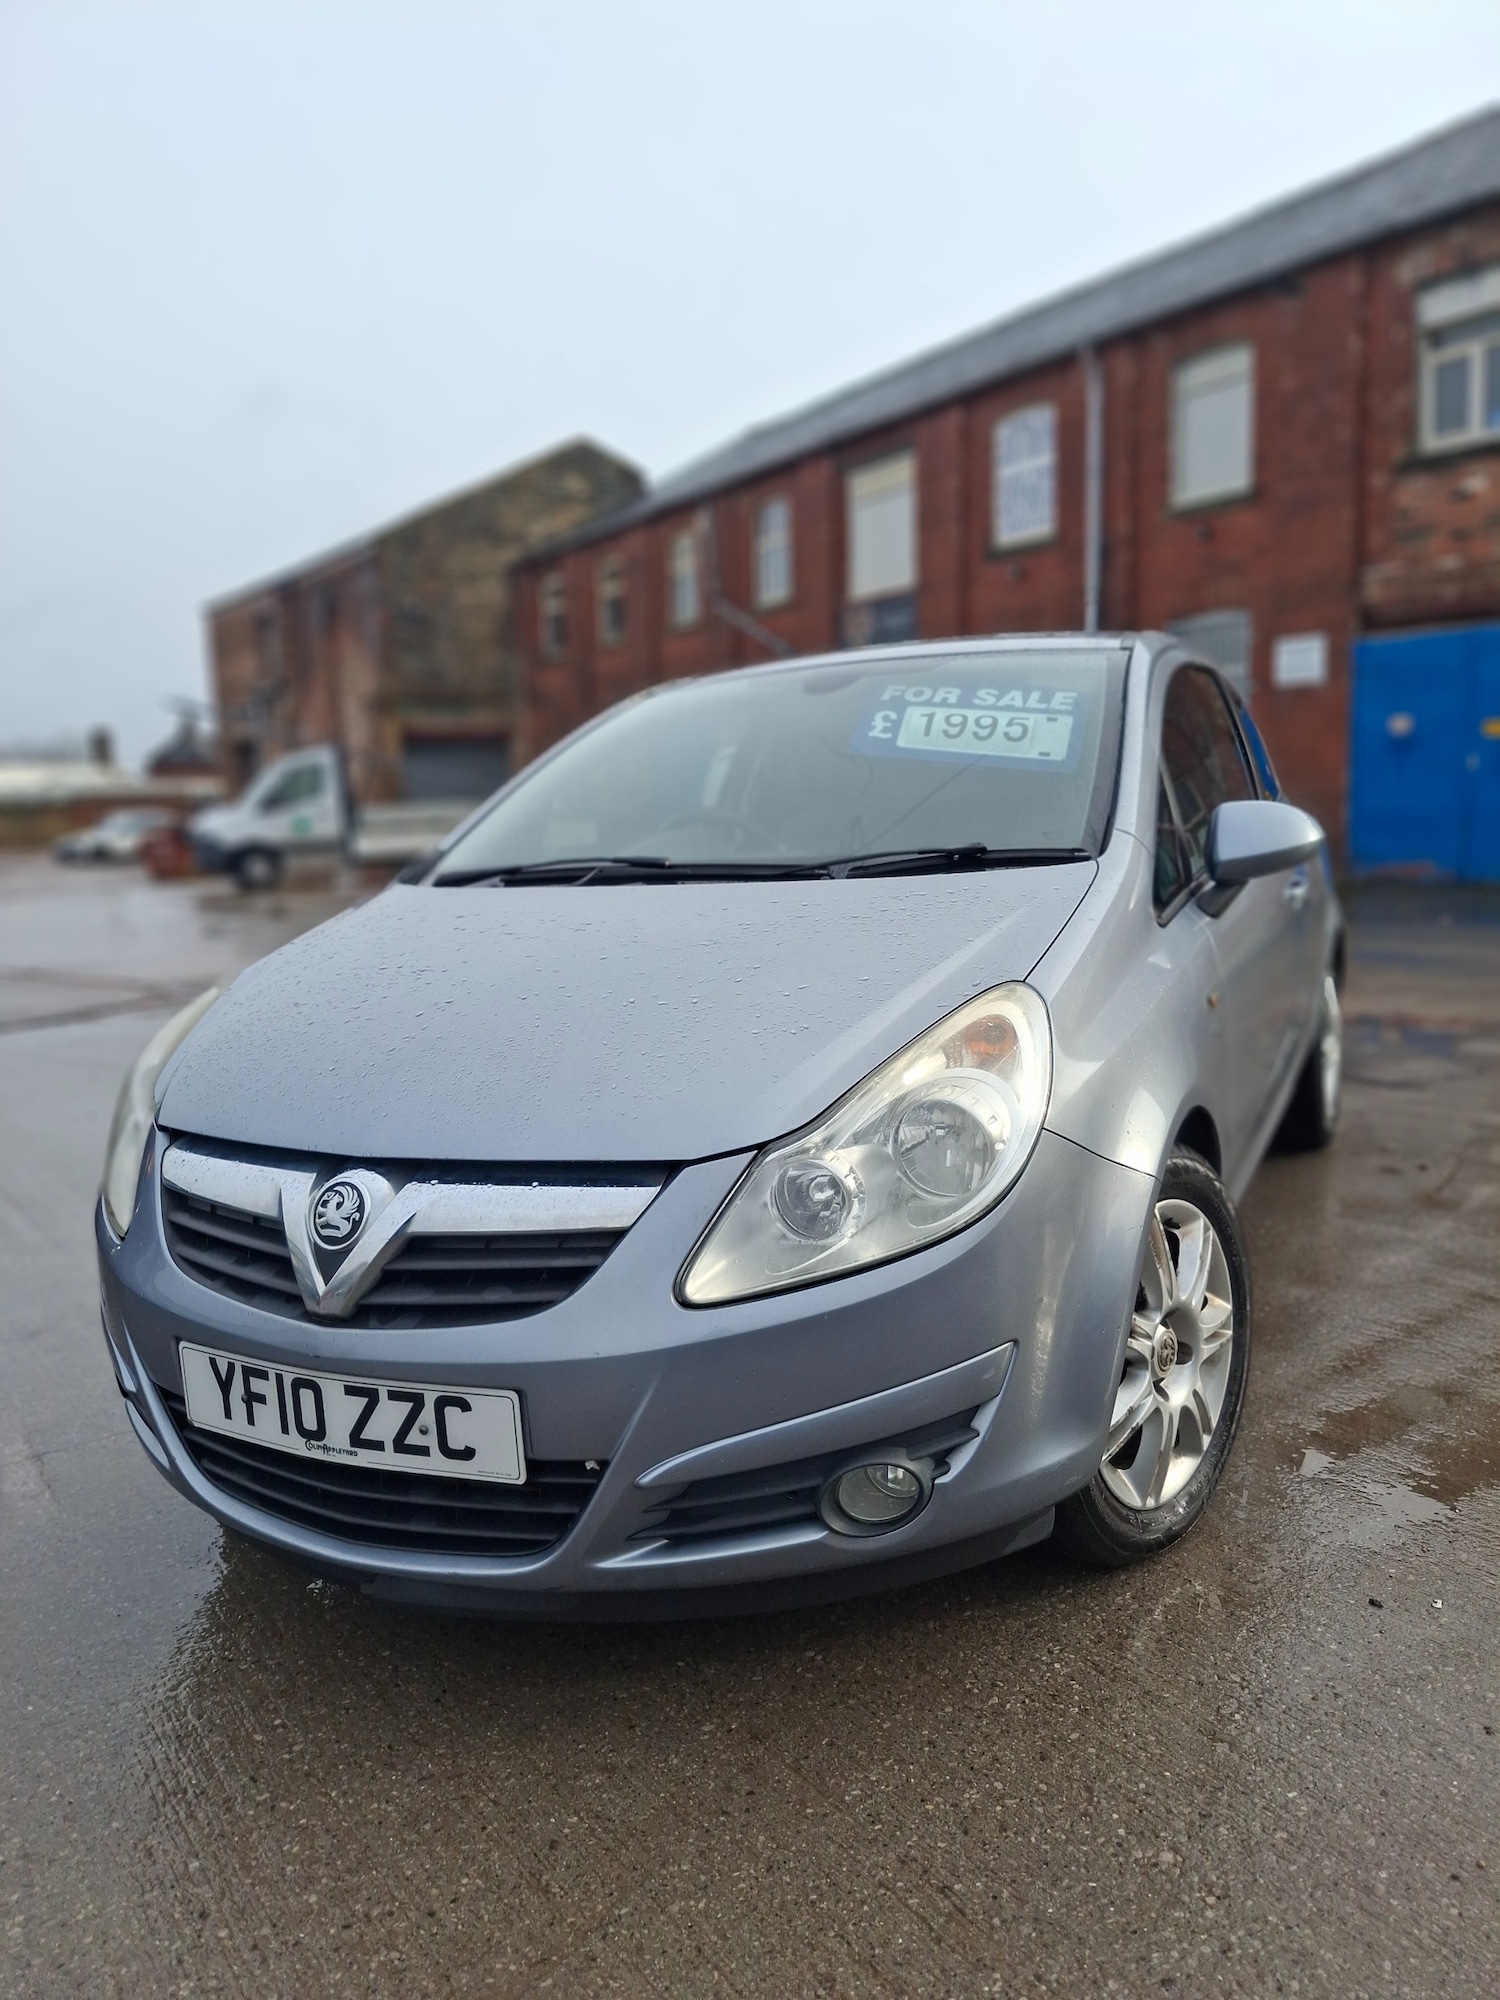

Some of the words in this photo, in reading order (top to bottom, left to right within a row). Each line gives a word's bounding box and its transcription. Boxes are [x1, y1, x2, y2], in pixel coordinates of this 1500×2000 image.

[880, 685, 962, 704] FOR
[972, 688, 1078, 710] SALE
[868, 710, 898, 739] £
[919, 712, 1030, 743] 1995
[209, 1356, 327, 1442] YF10
[343, 1384, 476, 1462] ZZC
